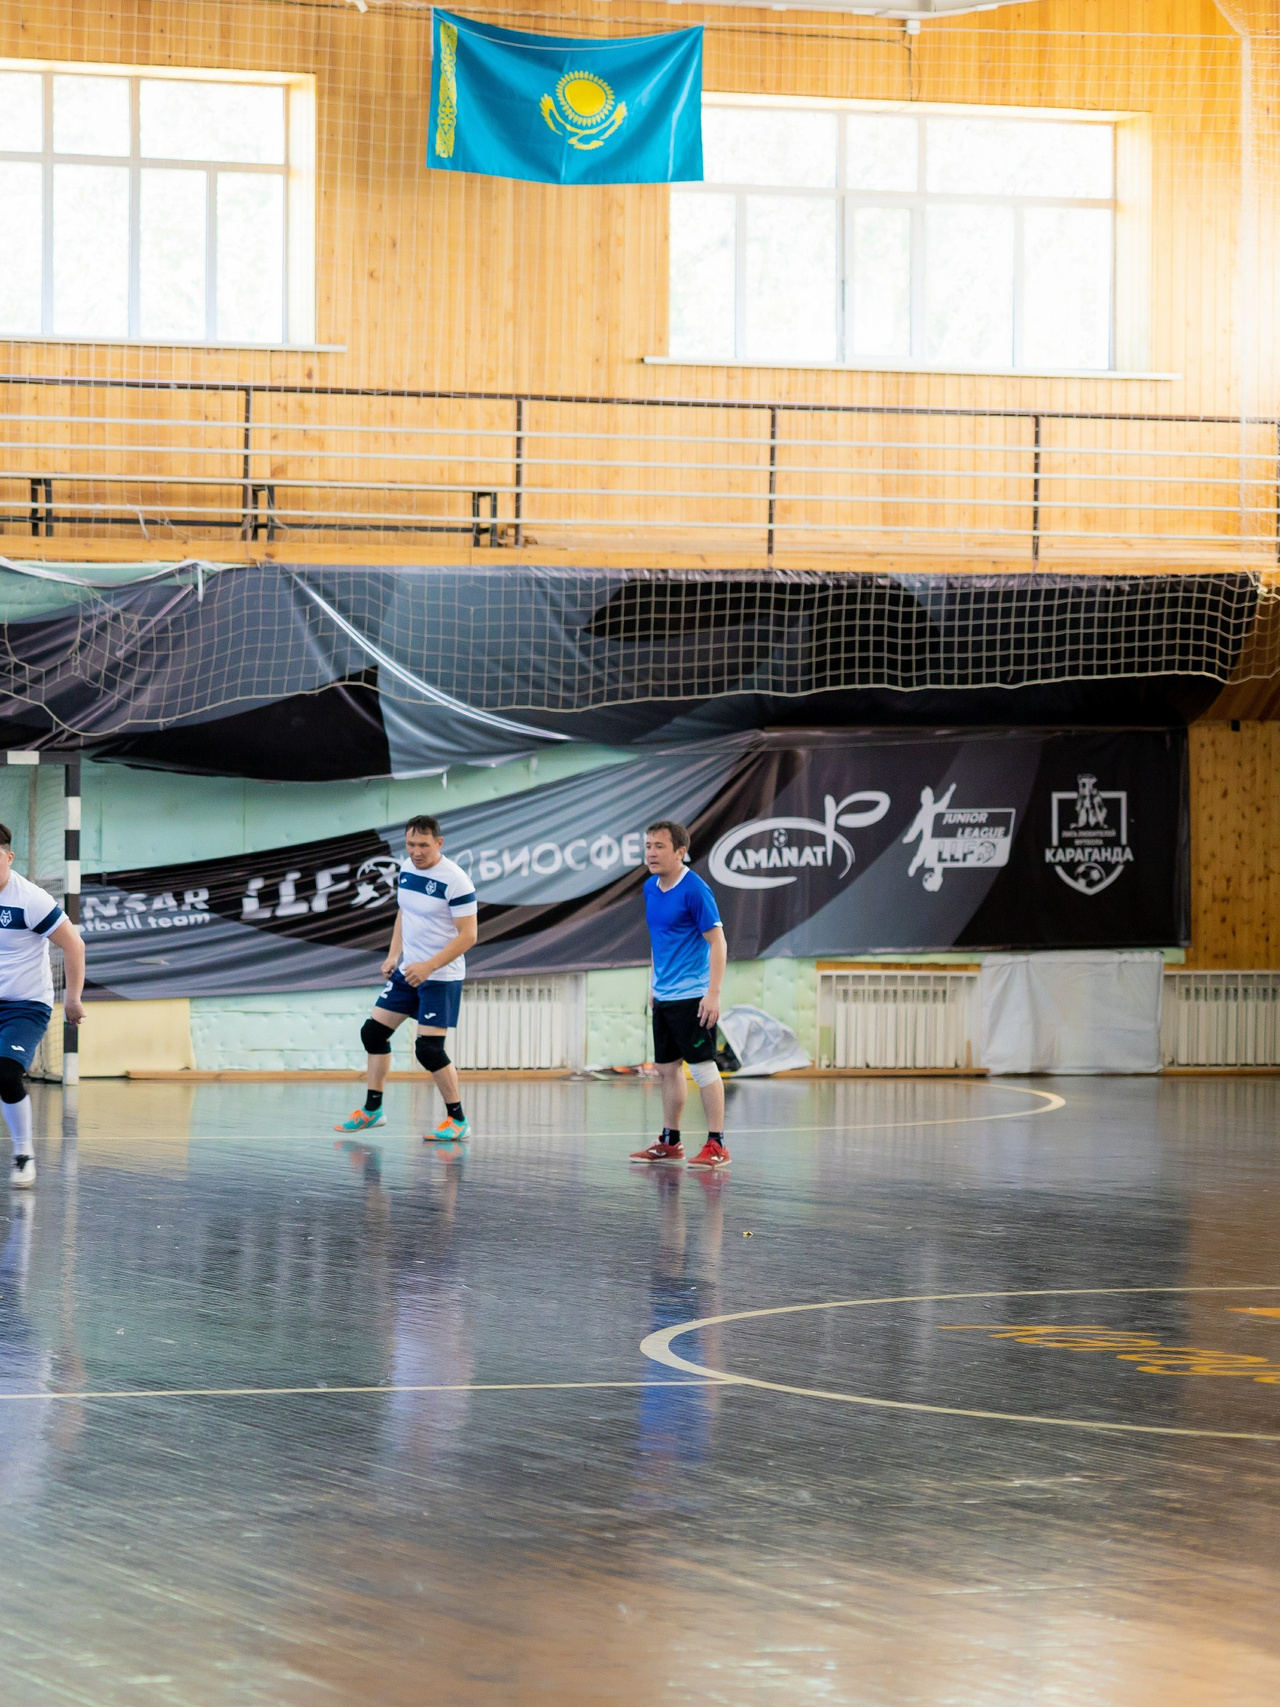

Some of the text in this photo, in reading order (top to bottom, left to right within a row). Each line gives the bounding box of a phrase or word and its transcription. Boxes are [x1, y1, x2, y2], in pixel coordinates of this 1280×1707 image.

[942, 812, 988, 825] JUNIOR
[957, 827, 1006, 839] LEAGUE
[479, 832, 690, 881] БИОСФЕ
[729, 846, 826, 871] AMANAT
[1044, 846, 1135, 864] КАРАГАНДА
[83, 888, 210, 919] NSAR
[148, 912, 210, 929] team
